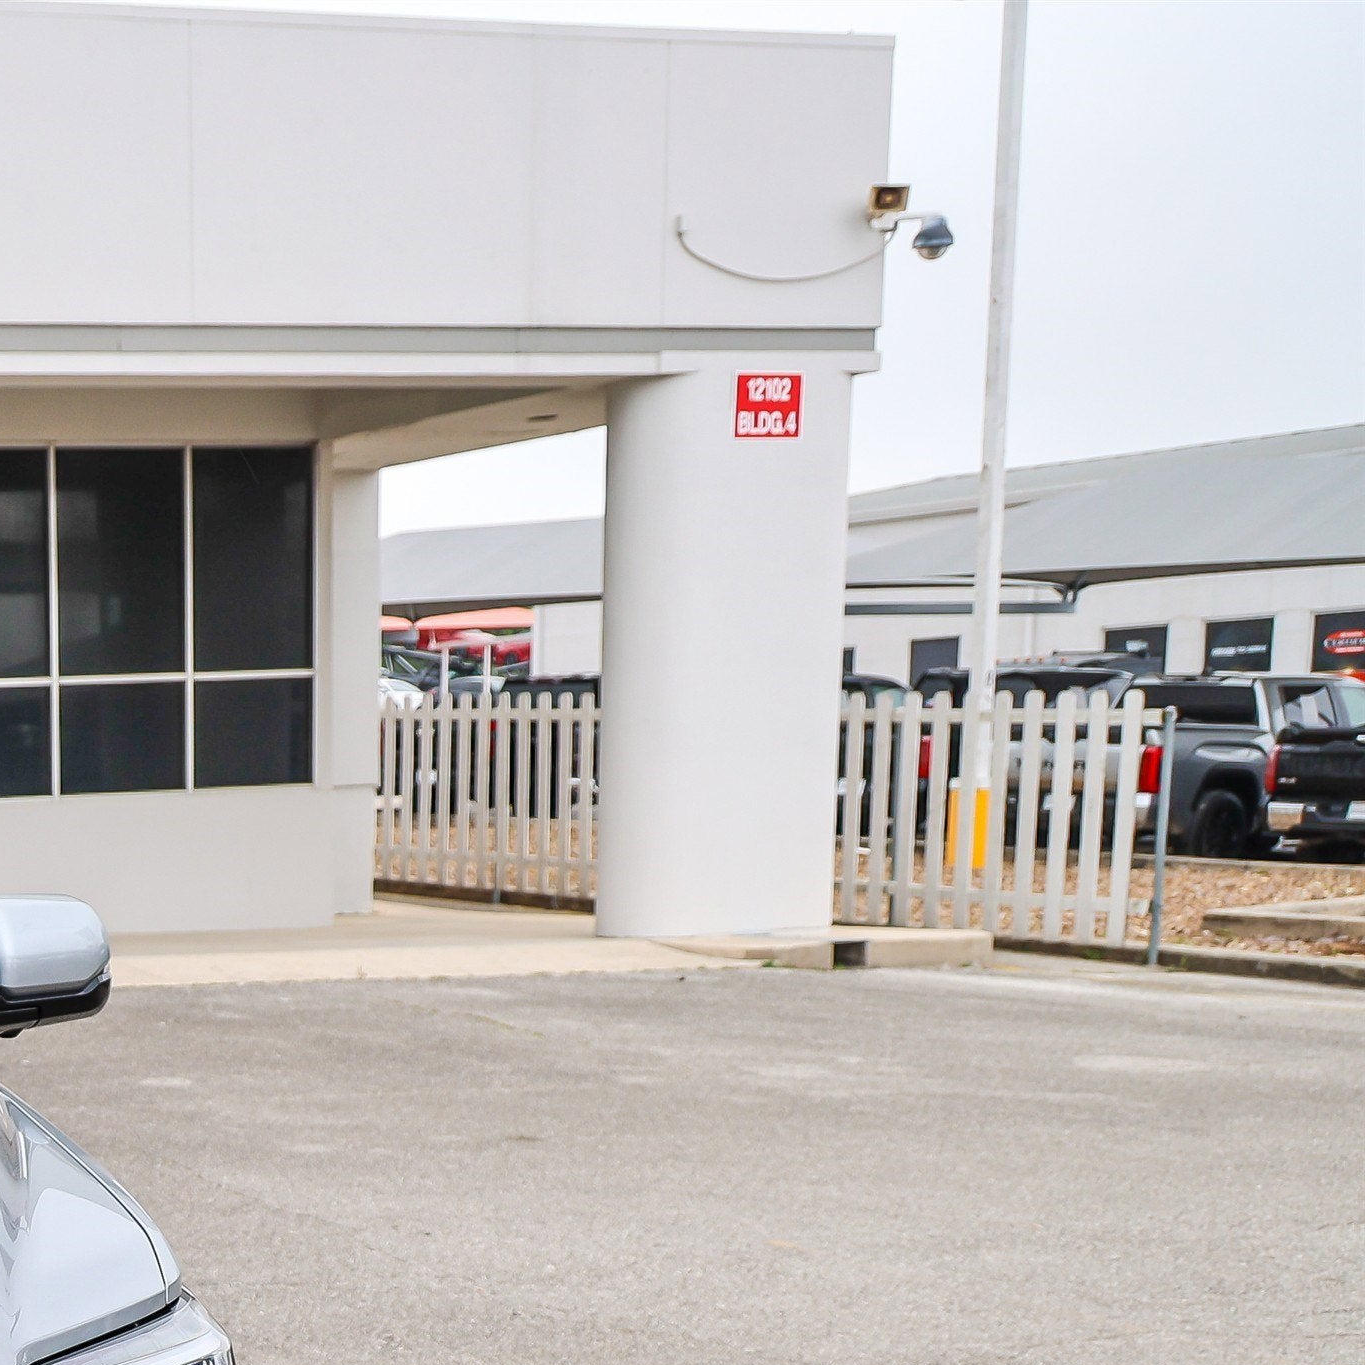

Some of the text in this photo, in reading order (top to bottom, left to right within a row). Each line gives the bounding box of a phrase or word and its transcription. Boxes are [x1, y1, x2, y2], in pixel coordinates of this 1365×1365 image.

[746, 377, 792, 402] 12102
[737, 410, 797, 435] BLDG 4
